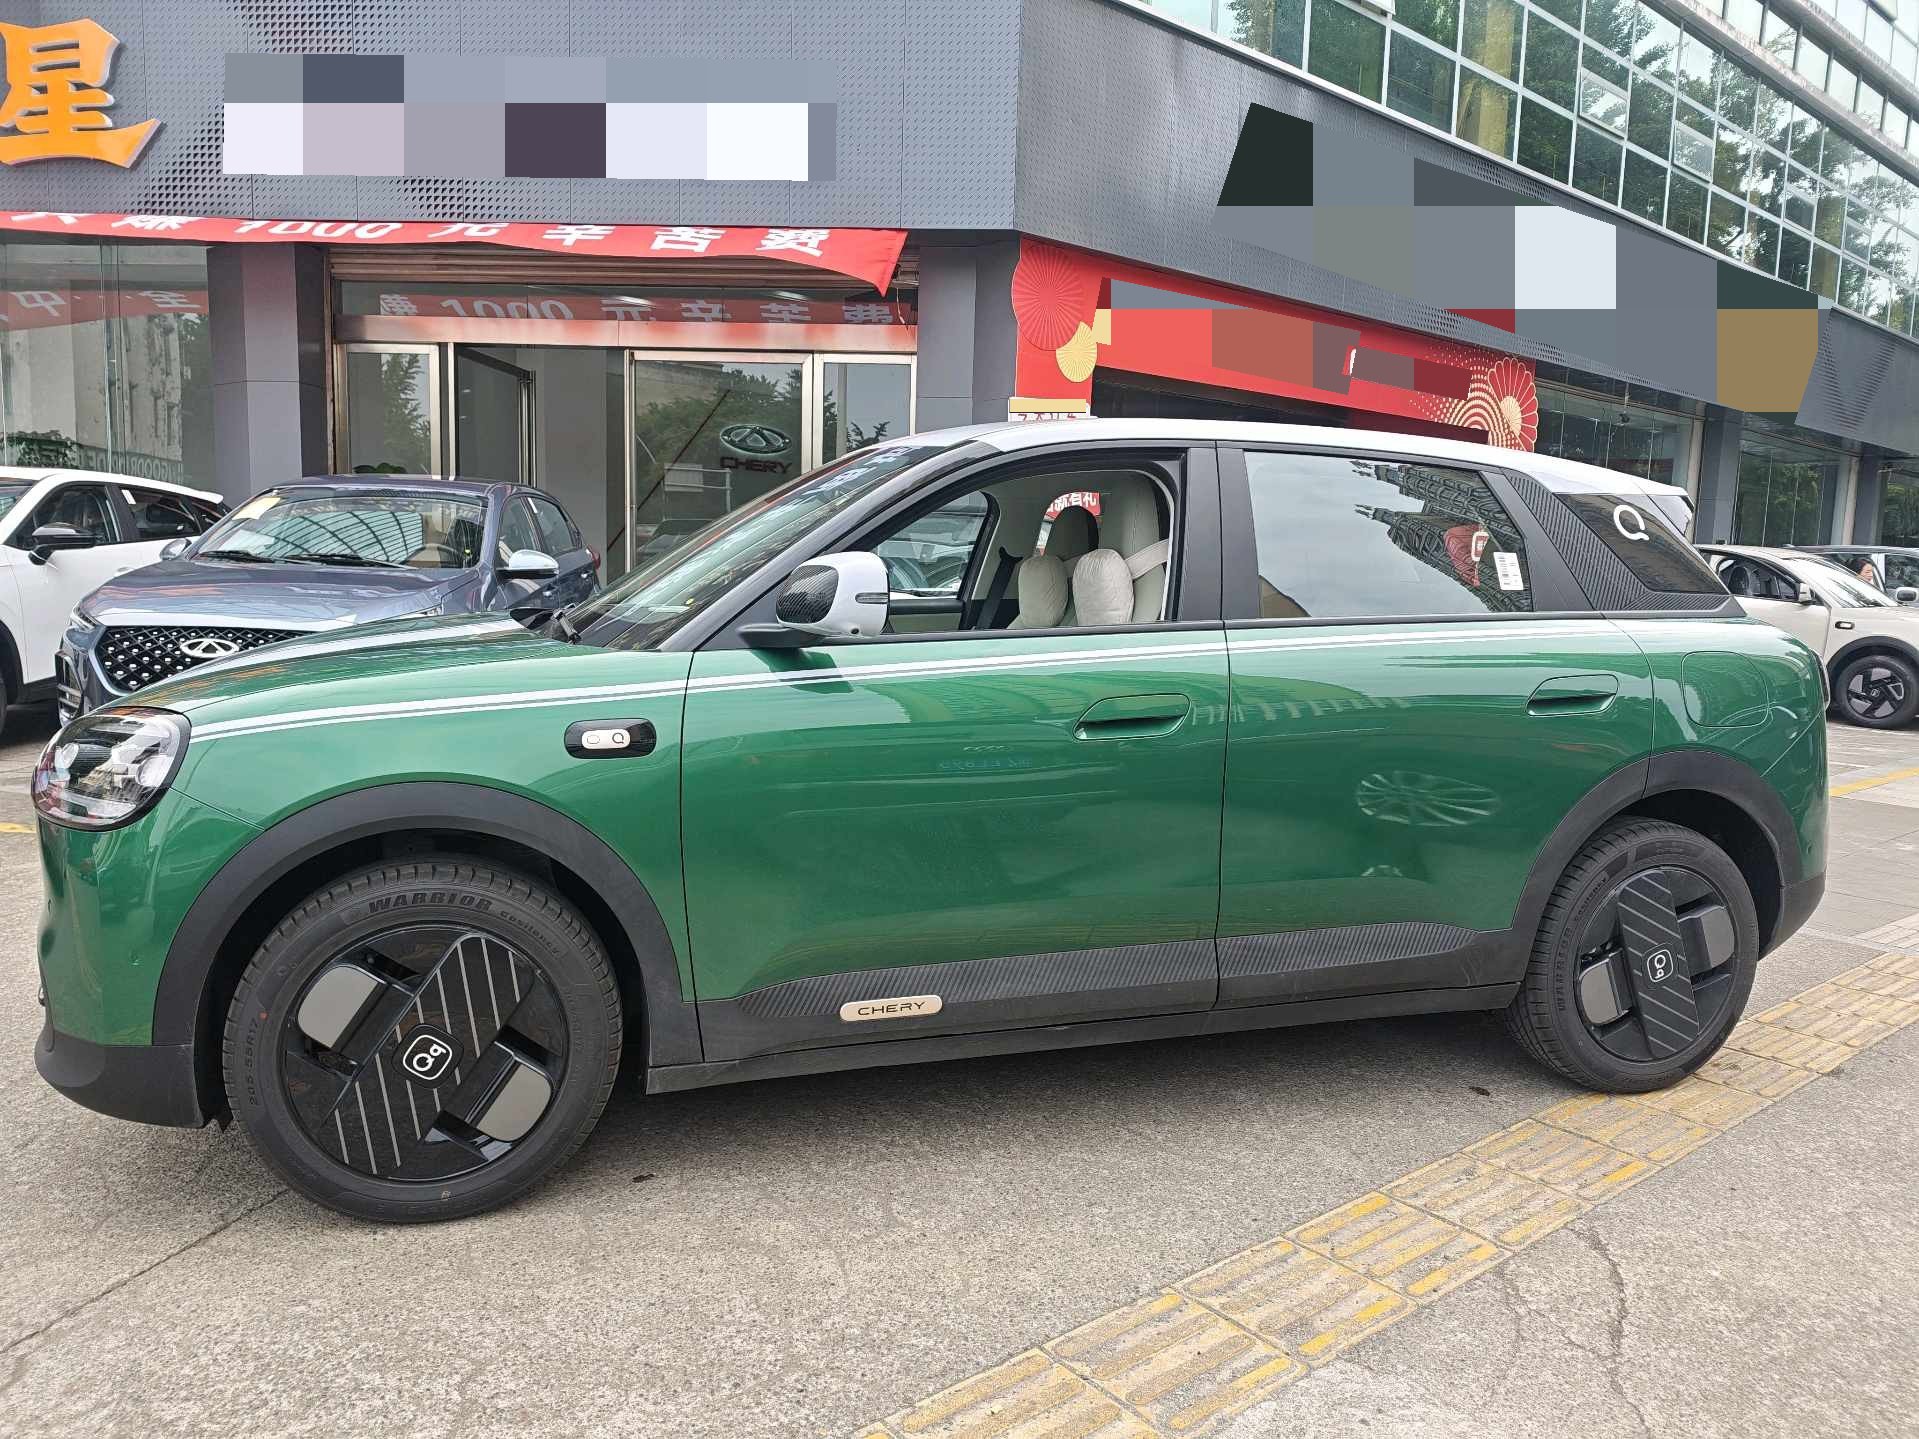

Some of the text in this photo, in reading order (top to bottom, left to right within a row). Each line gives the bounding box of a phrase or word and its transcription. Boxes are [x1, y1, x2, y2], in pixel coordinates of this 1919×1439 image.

[0, 17, 162, 169] 星
[720, 456, 792, 474] CHERY
[368, 891, 492, 913] WARRIOR
[857, 1001, 926, 1016] CHERY
